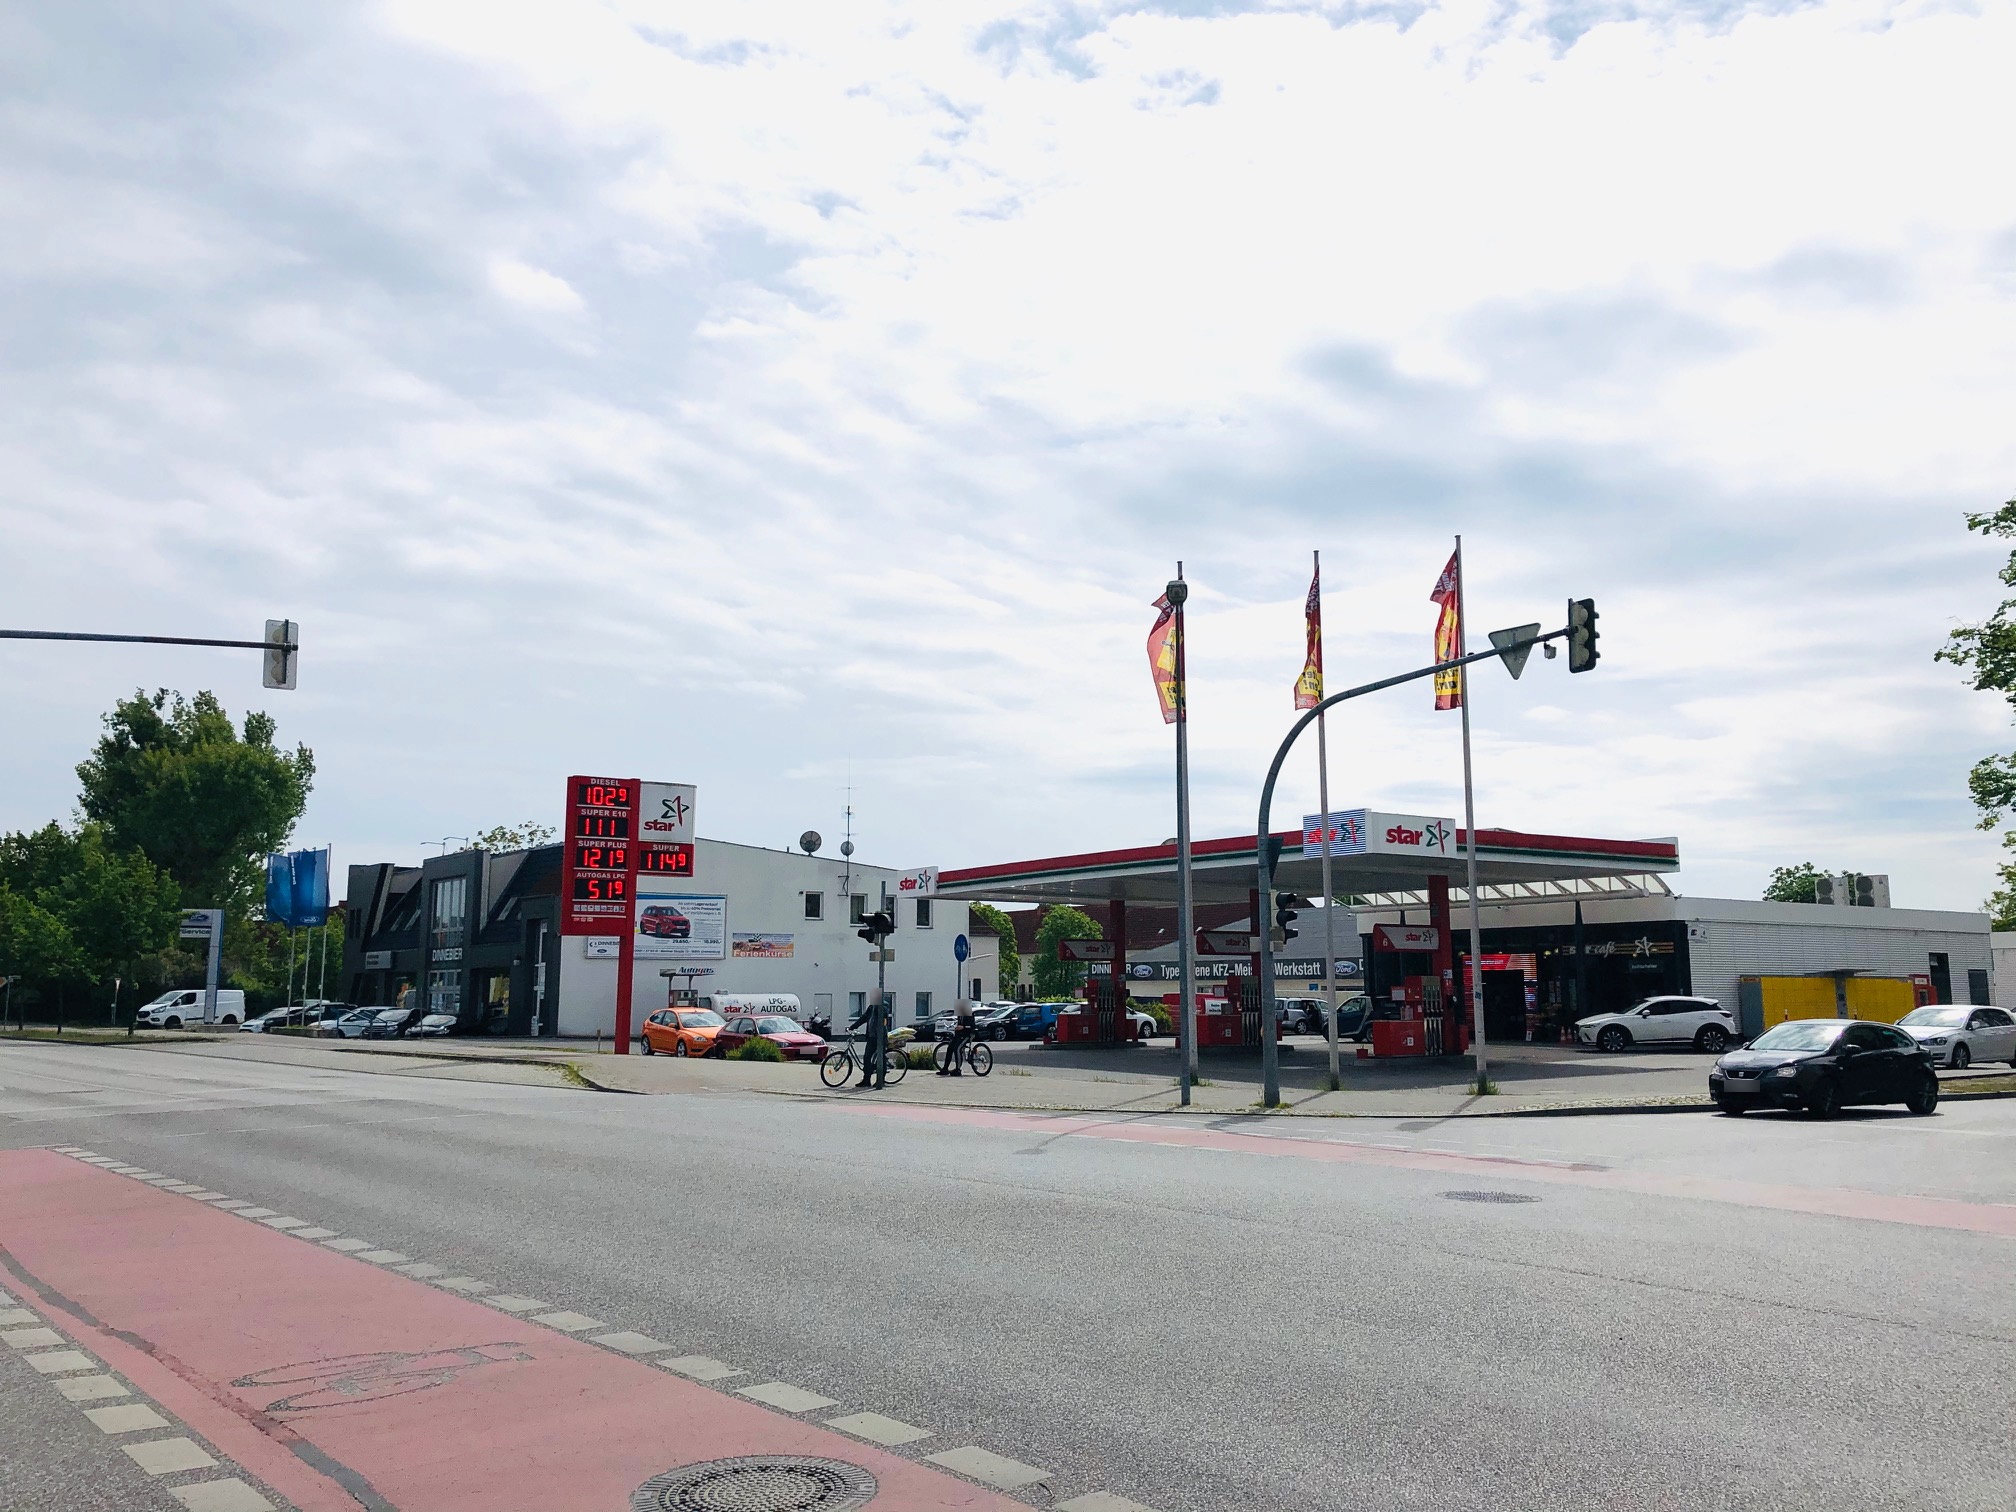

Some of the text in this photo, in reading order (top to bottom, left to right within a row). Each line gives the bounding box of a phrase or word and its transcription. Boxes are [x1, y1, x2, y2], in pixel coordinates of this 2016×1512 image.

[590, 778, 621, 786] DIESEL
[581, 808, 627, 818] SUPER E10
[643, 819, 675, 832] star
[1385, 824, 1424, 846] star
[578, 840, 627, 849] SUPER PLUS
[652, 844, 680, 852] SUPER
[899, 876, 918, 891] star
[1382, 938, 1388, 947] 6
[733, 949, 793, 958] Ferienkurse
[678, 966, 715, 974] Autogas
[723, 1005, 742, 1013] star
[760, 1005, 797, 1013] AUTOGAS
